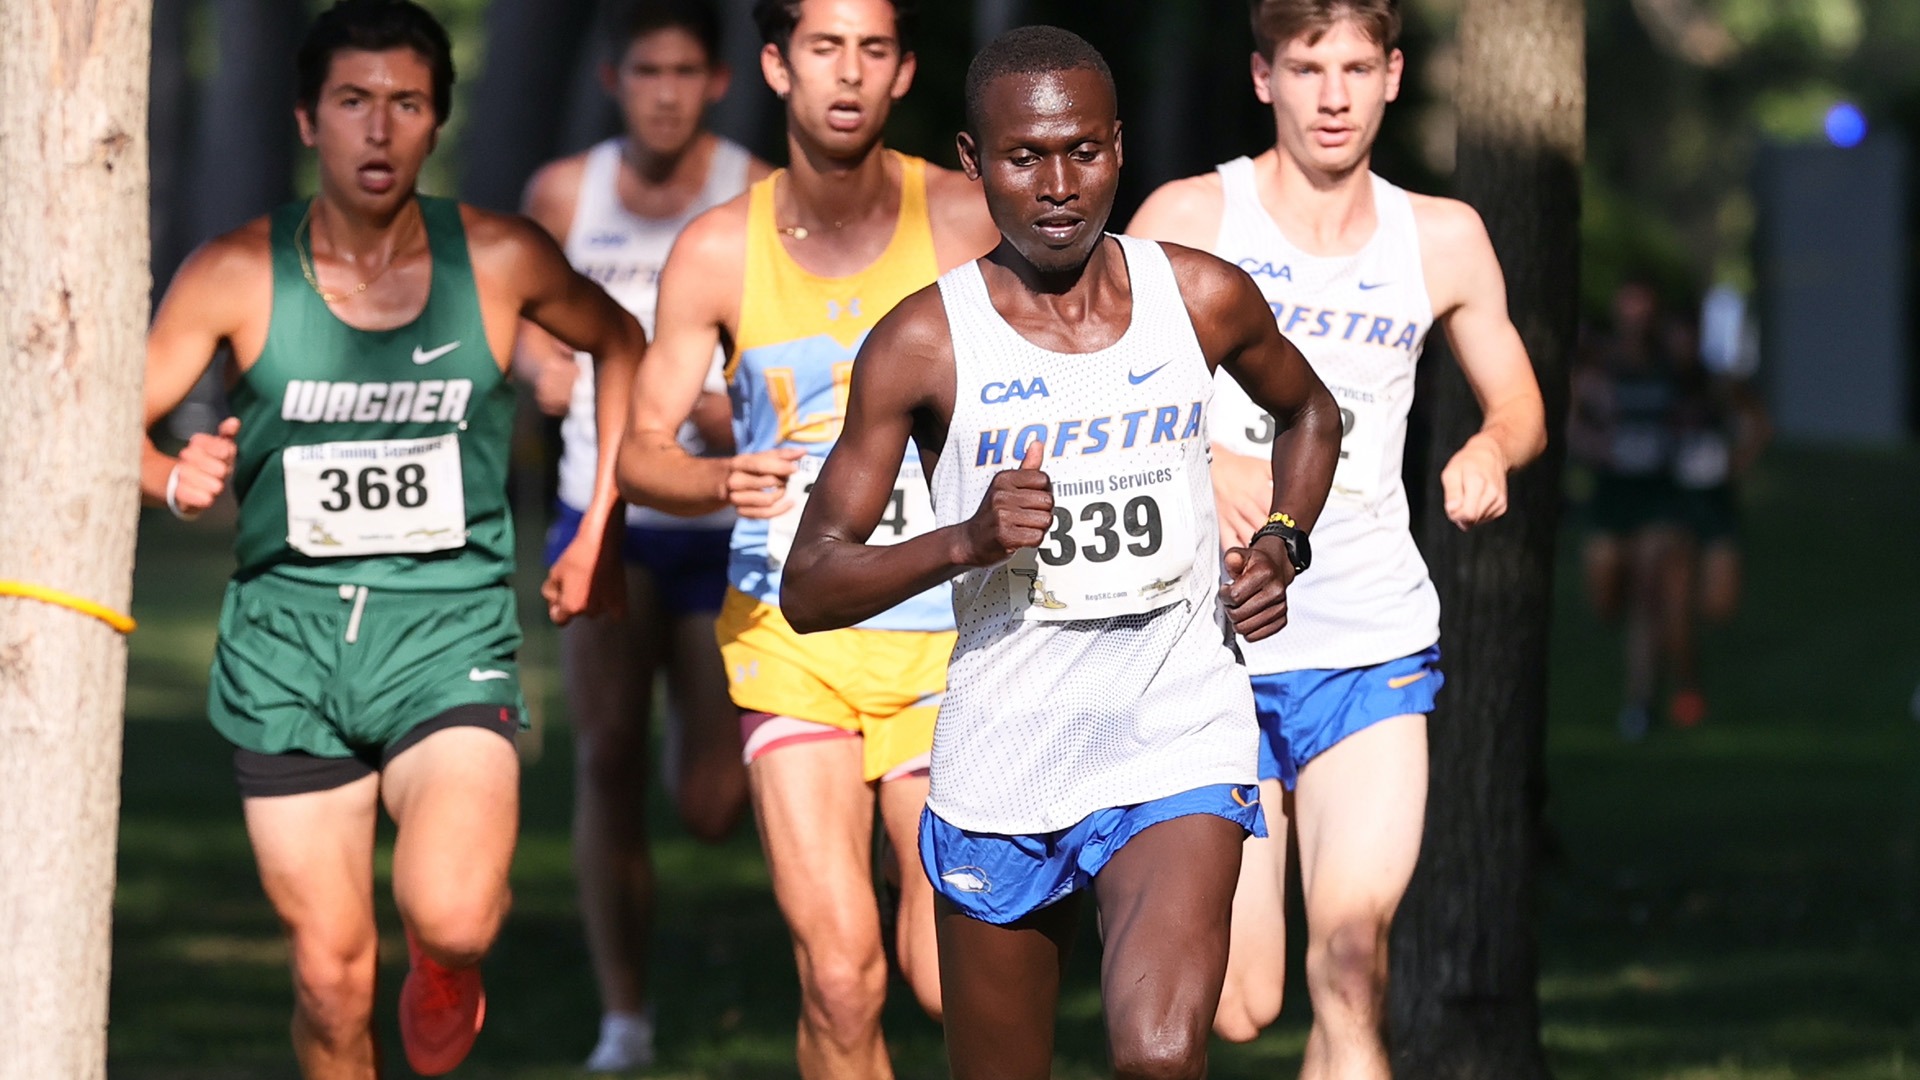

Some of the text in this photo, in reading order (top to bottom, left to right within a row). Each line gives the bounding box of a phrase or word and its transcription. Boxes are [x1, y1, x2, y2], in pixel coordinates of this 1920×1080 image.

[1236, 258, 1292, 282] CAA
[1268, 302, 1417, 350] FSTRA
[281, 379, 472, 423] WAGNER
[980, 377, 1050, 404] CAA
[975, 401, 1202, 467] HOFSTRA
[319, 463, 429, 512] 368
[1109, 467, 1172, 491] Services
[1038, 495, 1163, 566] 339
